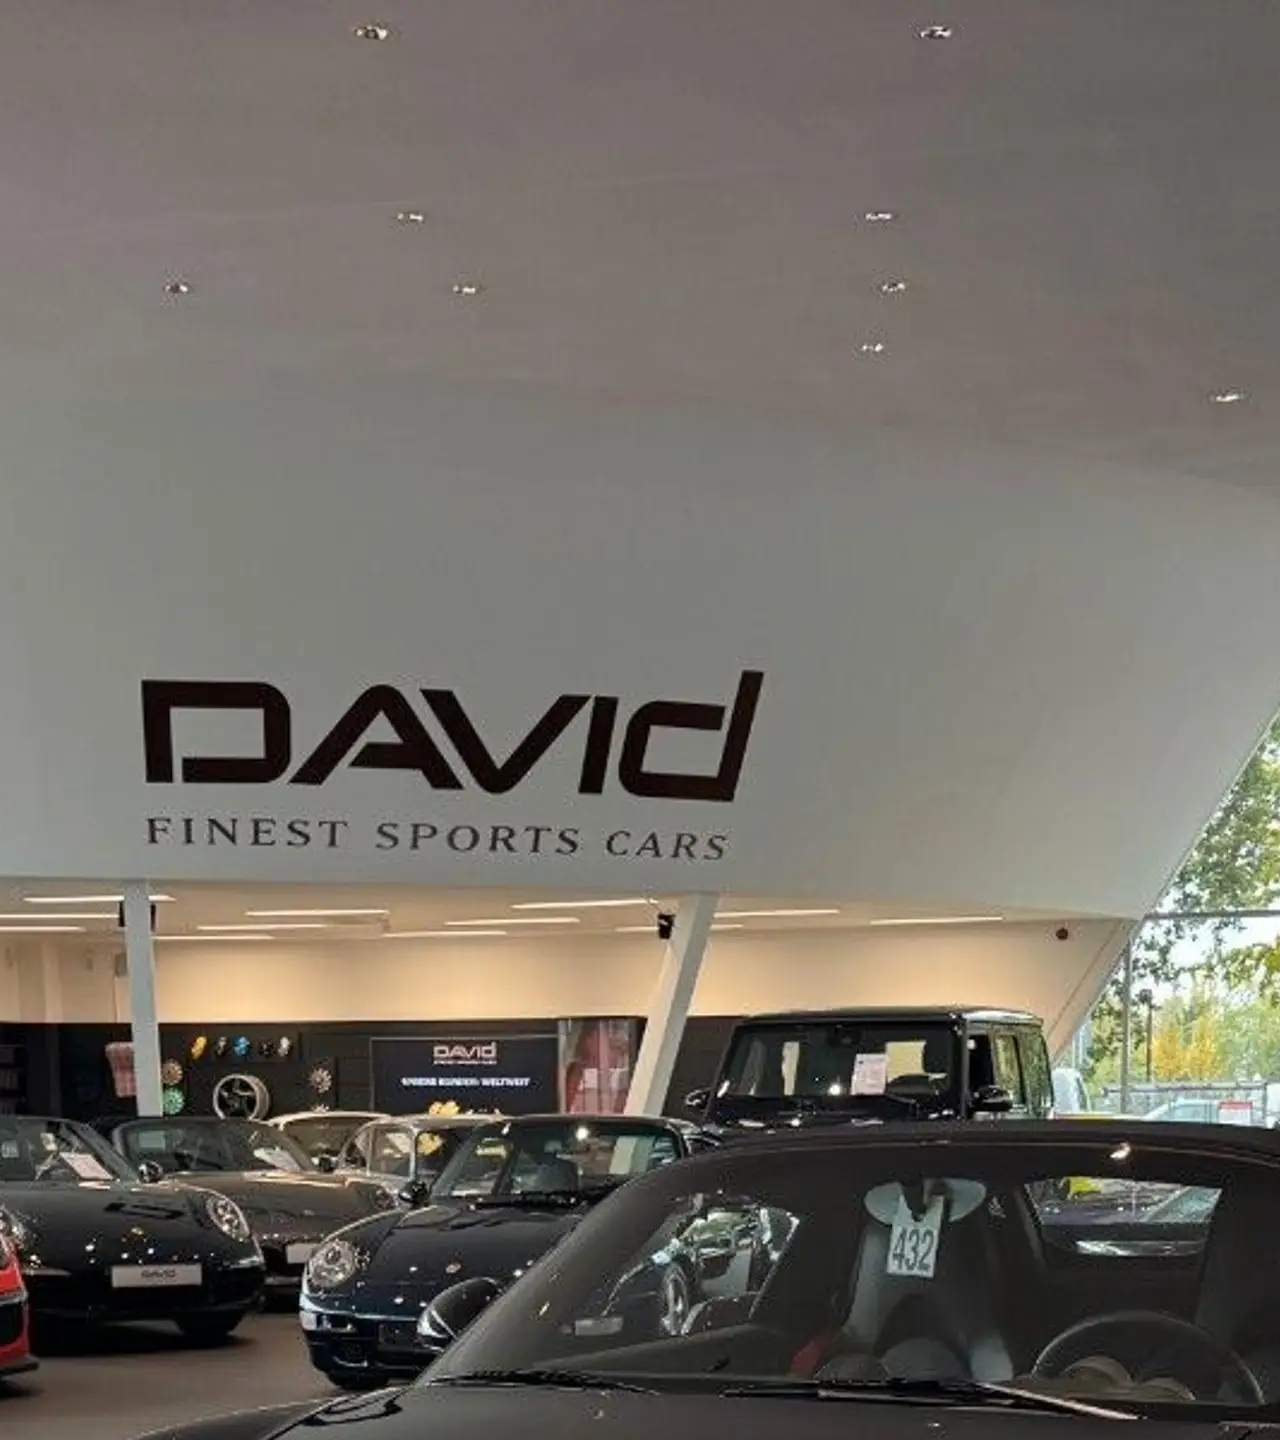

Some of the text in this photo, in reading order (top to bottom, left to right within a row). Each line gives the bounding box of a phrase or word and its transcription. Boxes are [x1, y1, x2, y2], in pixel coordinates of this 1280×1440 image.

[146, 817, 728, 862] FINEST SPORTS CARS
[892, 1228, 935, 1271] 432
